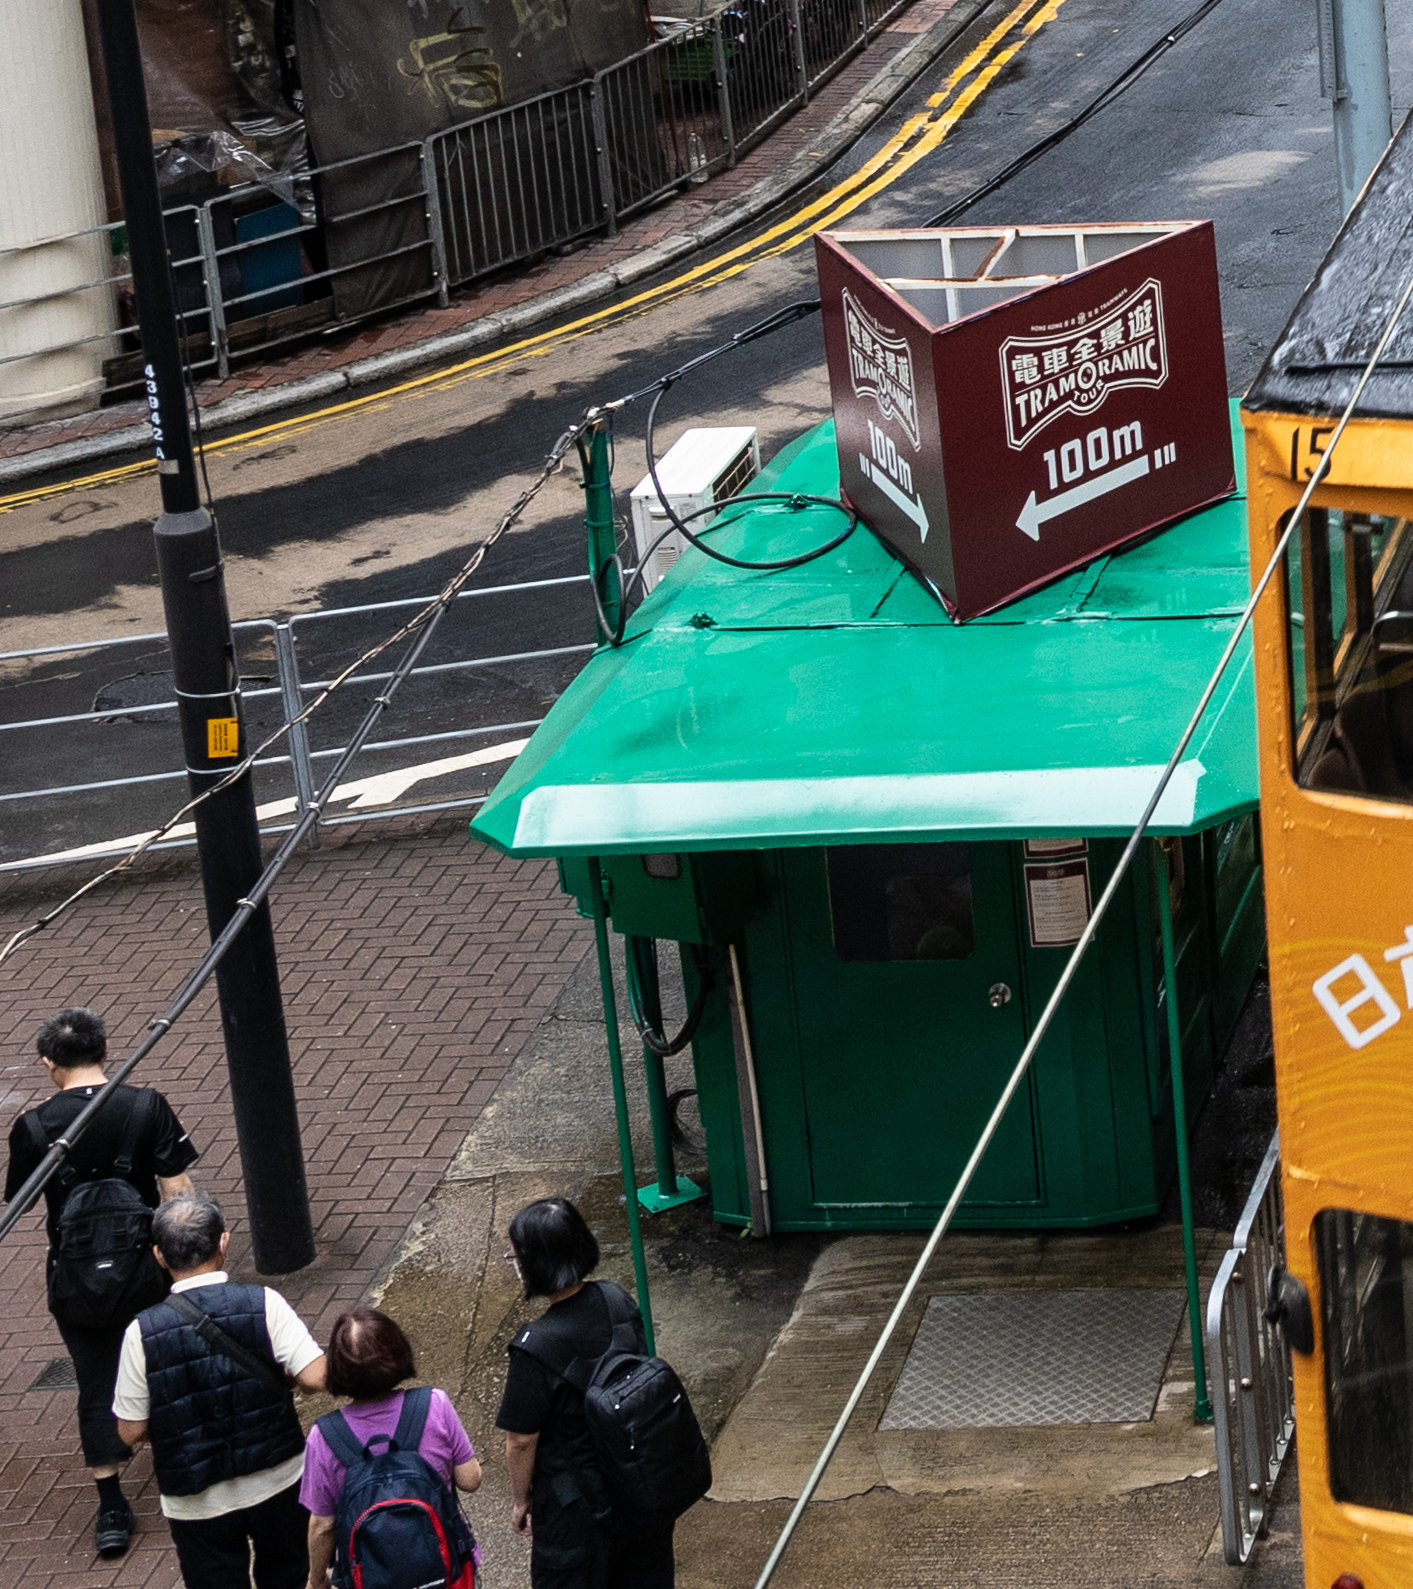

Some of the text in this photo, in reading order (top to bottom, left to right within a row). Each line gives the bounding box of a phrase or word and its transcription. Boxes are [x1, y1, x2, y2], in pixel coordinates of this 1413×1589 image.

[848, 309, 912, 387] 電車全景遊
[1011, 298, 1154, 385] 電車全景遊
[852, 347, 915, 430] TRAMORAMIC
[1015, 337, 1158, 428] TRAMORAMIC
[1073, 379, 1105, 404] TOUR
[867, 418, 914, 495] 100m
[1043, 420, 1143, 492] 100m
[1289, 427, 1334, 482] 15
